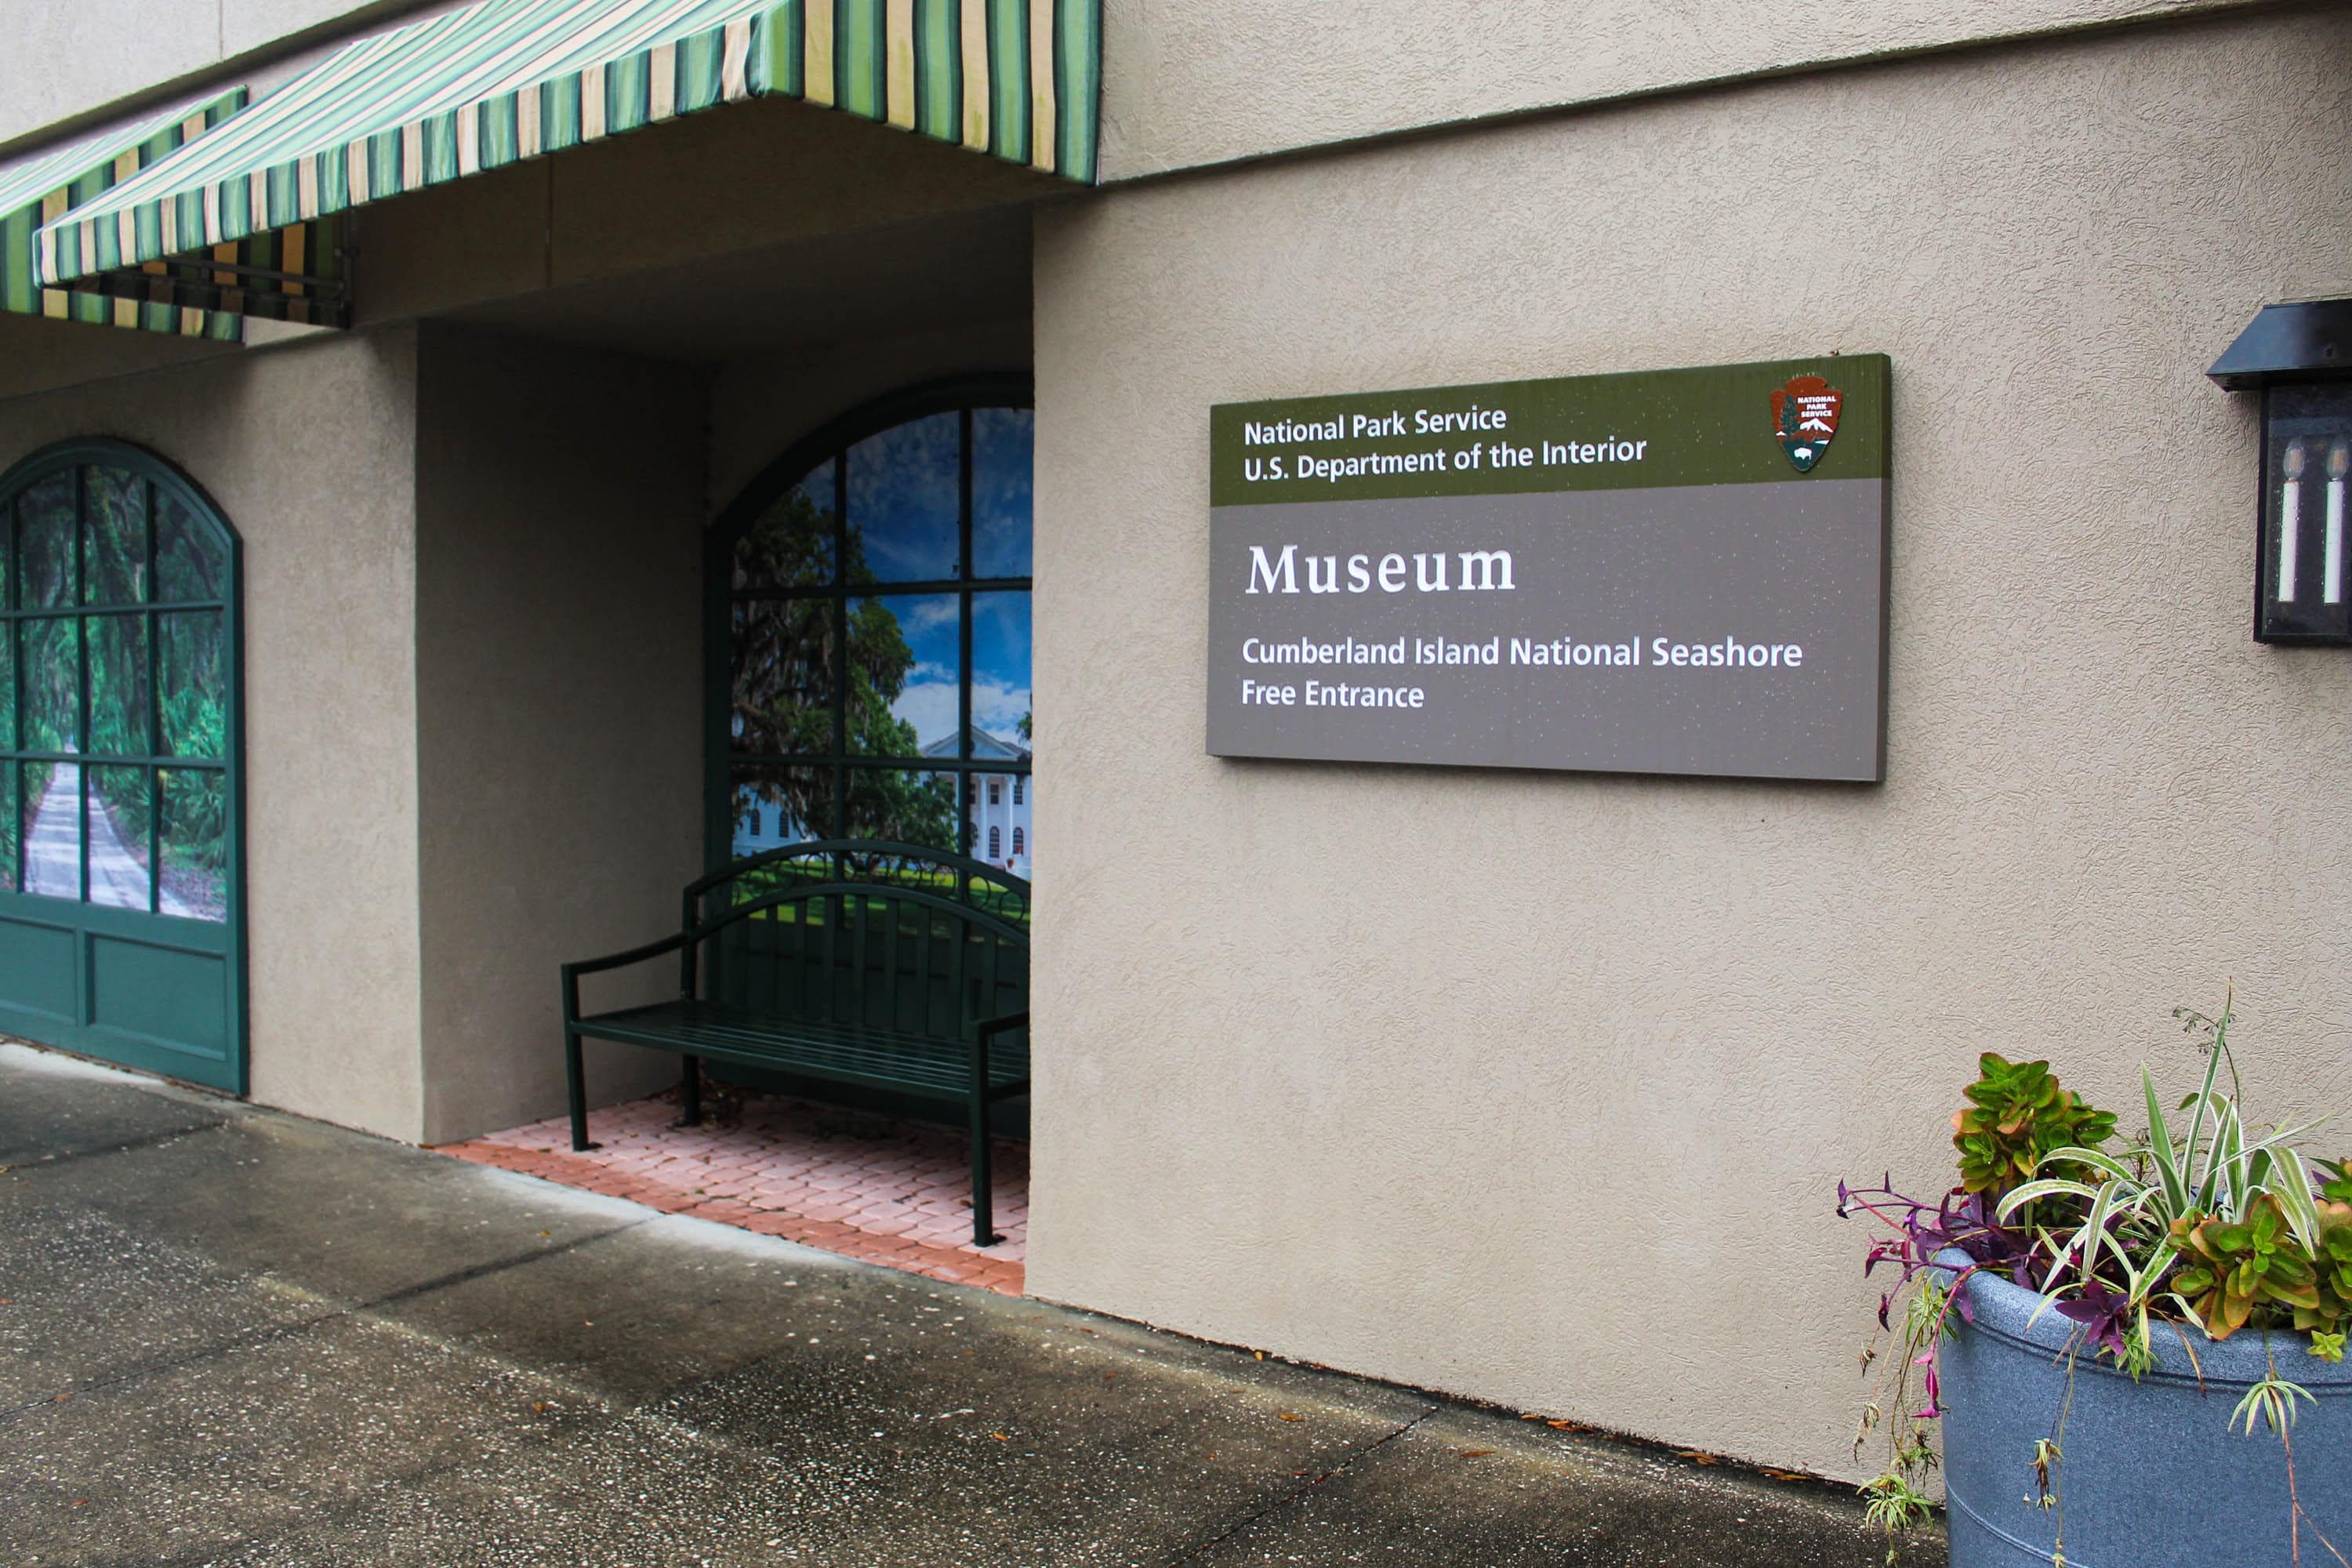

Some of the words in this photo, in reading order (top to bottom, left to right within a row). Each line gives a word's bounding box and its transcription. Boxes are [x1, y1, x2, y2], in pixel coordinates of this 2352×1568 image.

[1245, 416, 1344, 445] National
[1353, 412, 1406, 438] Park
[1414, 405, 1507, 434] Service
[1245, 456, 1289, 481] U.S.
[1298, 448, 1446, 483] Department
[1454, 443, 1482, 470] of
[1489, 441, 1534, 468] the
[1543, 435, 1647, 465] Interior
[1245, 544, 1516, 594] Museum
[1242, 636, 1405, 665] Cumberland
[1415, 636, 1499, 666] Island
[1510, 636, 1640, 666] National
[1652, 635, 1803, 667] Seashore
[1242, 679, 1297, 706] Free
[1305, 680, 1425, 708] Entrance
